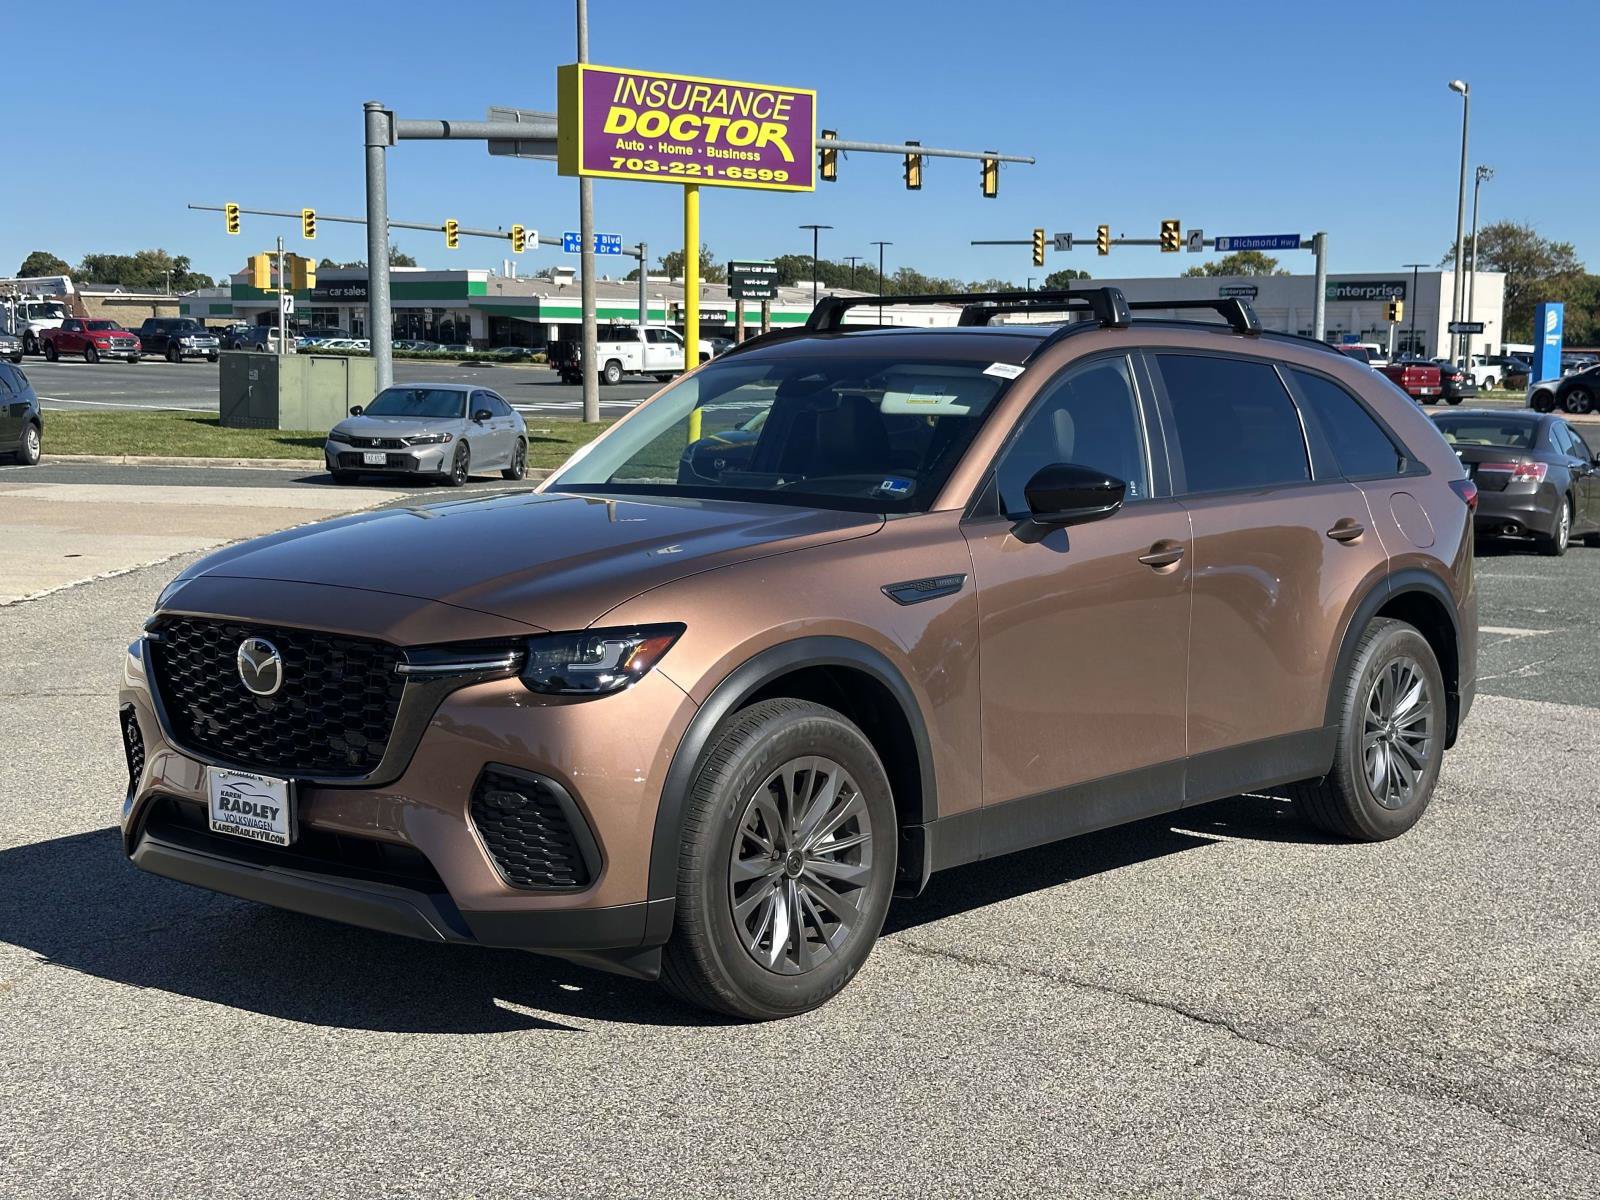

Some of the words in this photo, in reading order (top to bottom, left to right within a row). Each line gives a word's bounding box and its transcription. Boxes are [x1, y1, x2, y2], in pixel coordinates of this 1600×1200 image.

[613, 76, 795, 121] INSURANCE
[603, 106, 795, 163] DOCTOR
[615, 138, 645, 152] Auto
[658, 142, 693, 156] Home
[706, 147, 761, 162] Business
[609, 156, 789, 182] 703-221-6599
[601, 235, 621, 245] Blvd
[1233, 238, 1277, 248] Richmond
[600, 245, 610, 253] Dr
[329, 288, 342, 296] car
[343, 285, 367, 296] sales
[1326, 284, 1404, 298] enterprise
[710, 312, 727, 320] sales
[220, 790, 242, 799] KAREN
[218, 797, 280, 820] RADLEY
[223, 812, 273, 831] VOLKSWAGEN
